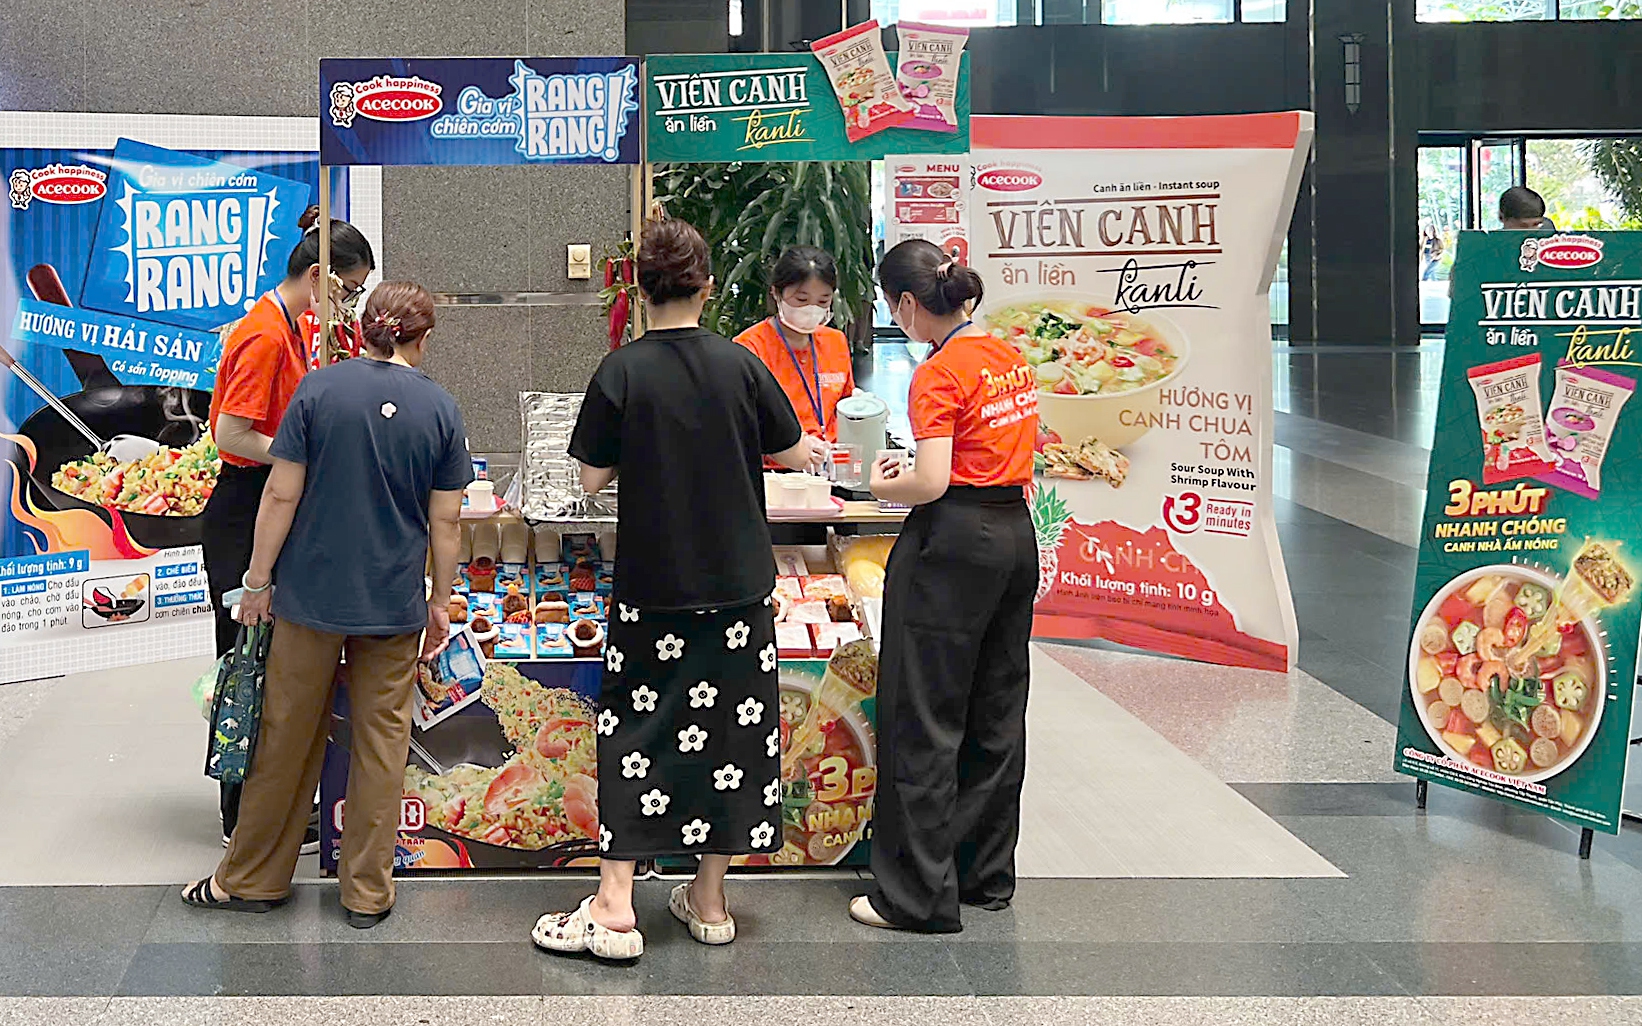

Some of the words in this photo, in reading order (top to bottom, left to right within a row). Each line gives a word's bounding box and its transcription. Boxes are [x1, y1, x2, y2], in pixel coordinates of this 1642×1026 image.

[355, 79, 383, 94] Cook
[385, 78, 440, 94] happiness
[526, 76, 605, 113] RANG
[655, 74, 724, 109] VIÊN
[728, 73, 808, 105] CANH
[460, 90, 493, 115] Gia
[498, 97, 515, 119] vị
[434, 116, 478, 135] chiên
[479, 117, 517, 135] cơm
[665, 114, 685, 133] ăn
[689, 113, 717, 133] liền
[32, 168, 55, 180] Cook
[58, 166, 104, 180] happiness
[138, 164, 165, 188] Gia
[188, 171, 226, 187] chiên
[228, 172, 258, 187] cơm
[926, 164, 960, 173] MENU
[977, 162, 997, 171] Cook
[1093, 184, 1117, 193] Canh
[1119, 182, 1131, 192] ăn
[1133, 181, 1151, 191] liền
[1158, 181, 1194, 190] Instant
[1195, 180, 1220, 190] soup
[136, 197, 243, 249] RANG
[989, 201, 1085, 249] VIÊN
[1097, 203, 1220, 247] CANH
[1539, 237, 1559, 247] Cook
[1561, 236, 1602, 248] happiness
[1001, 263, 1029, 285] ăn
[1037, 260, 1076, 286] liền
[1481, 283, 1549, 320] VIÊN
[1555, 287, 1642, 319] CANH
[19, 311, 75, 339] HƯƠNG
[81, 322, 100, 346] VỊ
[102, 322, 148, 352] HẢI
[153, 332, 203, 363] SẢN
[1486, 327, 1506, 346] ăn
[1510, 326, 1538, 346] liền
[111, 359, 126, 373] Có
[149, 362, 199, 386] Topping
[1234, 394, 1253, 415] VỊ
[1119, 409, 1181, 430] CANH
[1188, 415, 1253, 436] CHUA
[1199, 438, 1252, 462] TÔM
[1171, 462, 1195, 473] Sour
[1198, 465, 1224, 477] Soup
[1226, 467, 1255, 479] With
[1171, 474, 1209, 488] Shrimp
[1211, 478, 1257, 491] Flavour
[1175, 491, 1202, 526] 3
[1206, 503, 1237, 518] Ready
[1241, 506, 1251, 518] in
[1205, 515, 1251, 531] minutes
[1434, 521, 1498, 538] NHANH
[1501, 516, 1567, 536] CHÓNG
[1443, 542, 1476, 553] CANH
[1477, 538, 1502, 552] NHÀ
[1524, 537, 1558, 550] NÓNG
[17, 562, 44, 576] lượng
[46, 558, 67, 574] tịnh:
[68, 557, 75, 569] 9
[76, 559, 83, 571] g
[47, 580, 63, 590] Cho
[1060, 571, 1091, 587] Khối
[1095, 577, 1135, 596] lượng
[1139, 581, 1172, 598] tịnh:
[1176, 583, 1197, 600] 10
[1201, 590, 1214, 606] g
[1, 598, 16, 608] vào
[27, 607, 42, 617] cho
[45, 605, 62, 615] cơm
[65, 603, 80, 613] vào
[171, 607, 191, 617] chiên
[18, 620, 39, 631] trong
[50, 616, 68, 628] phút
[1471, 767, 1506, 782] ACECOOK
[1528, 783, 1545, 793] NAM
[823, 830, 863, 847] CANH
